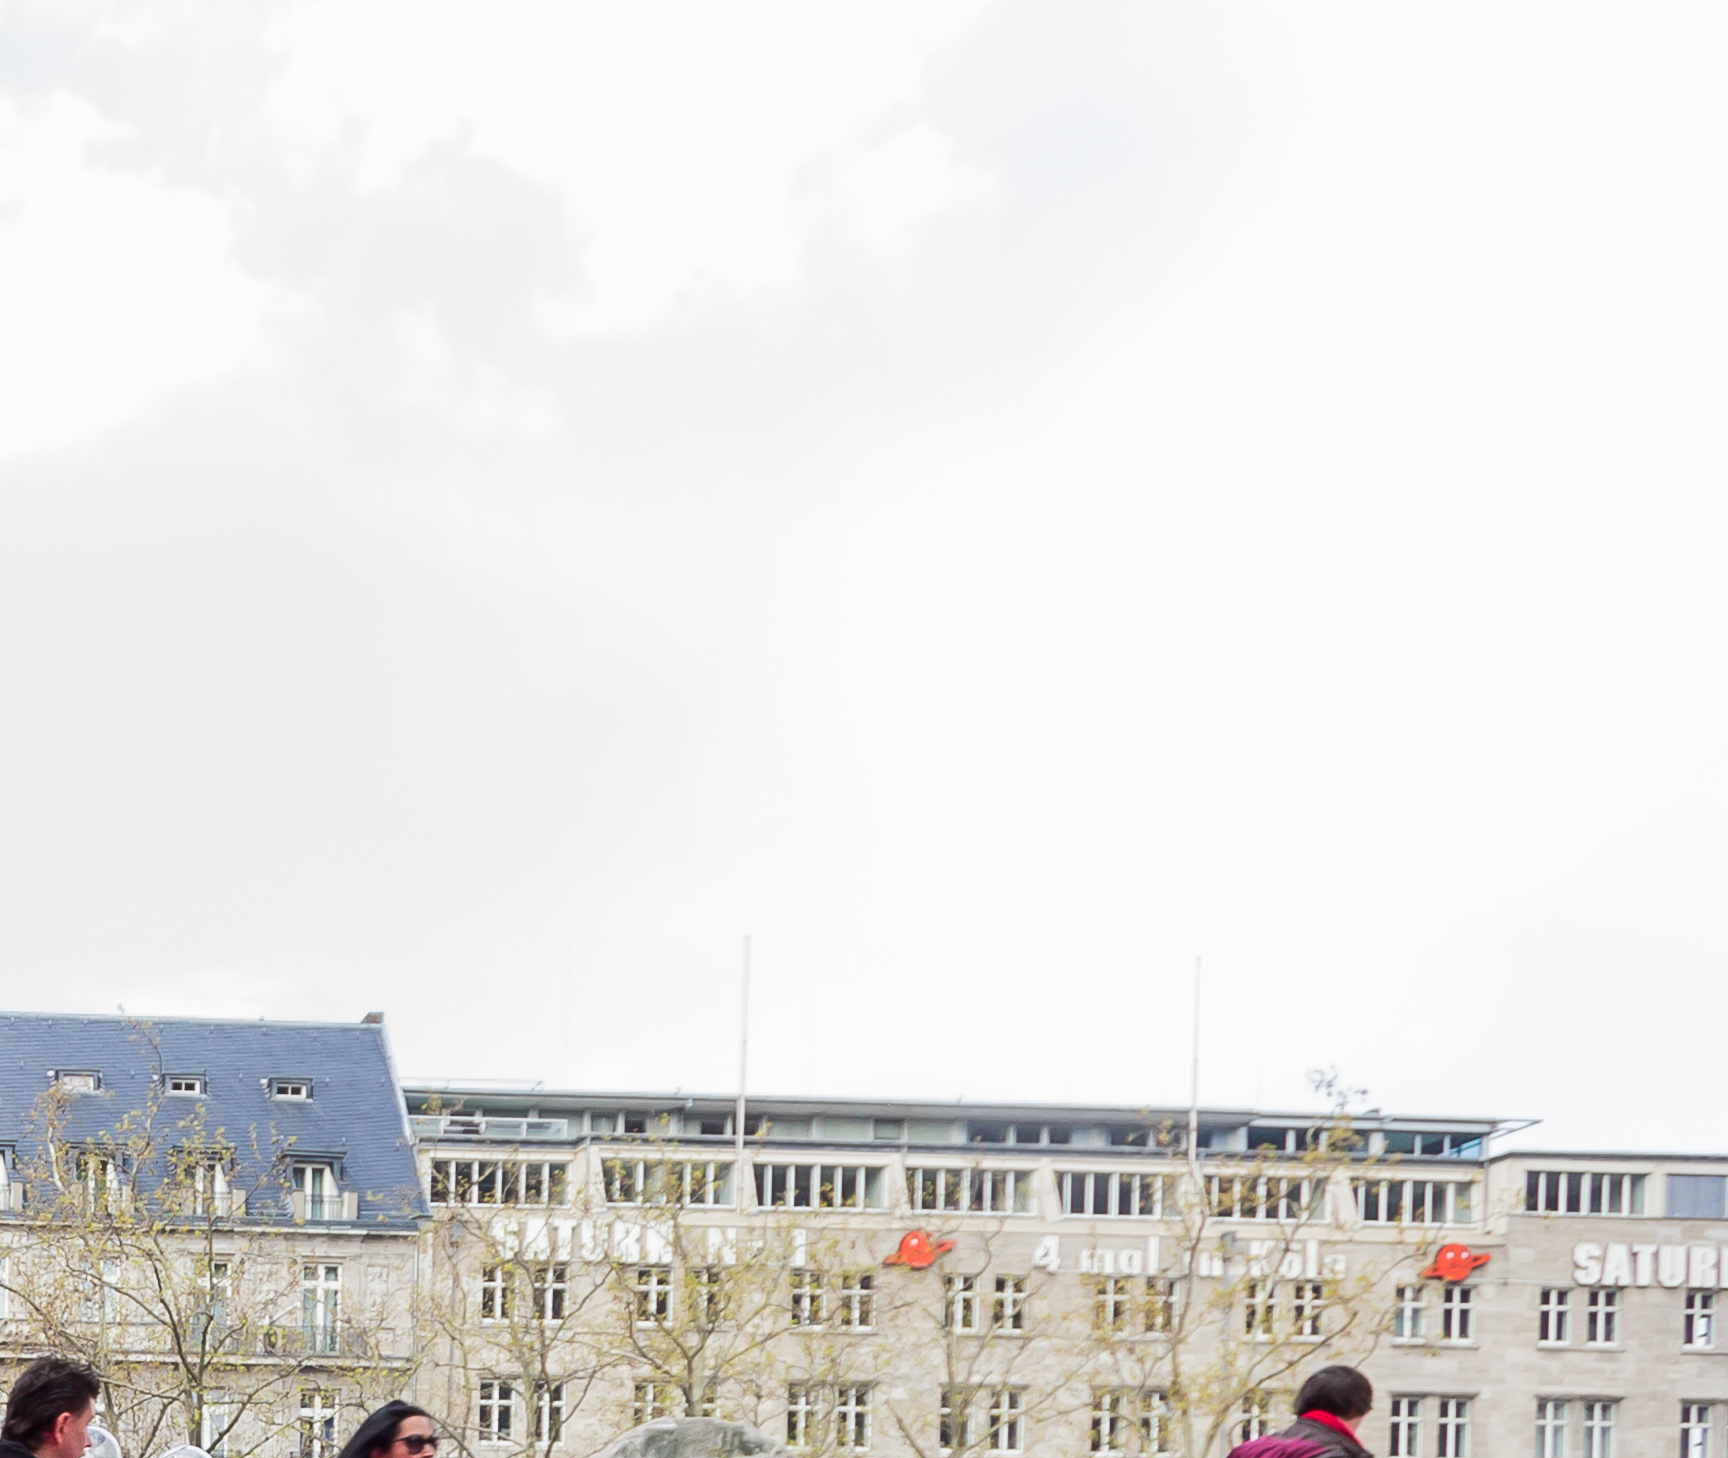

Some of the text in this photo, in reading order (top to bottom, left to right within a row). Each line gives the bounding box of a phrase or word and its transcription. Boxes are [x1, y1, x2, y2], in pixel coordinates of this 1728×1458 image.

[492, 1216, 675, 1264] SATURN
[1032, 1235, 1060, 1272] 4
[1080, 1235, 1160, 1274] mal
